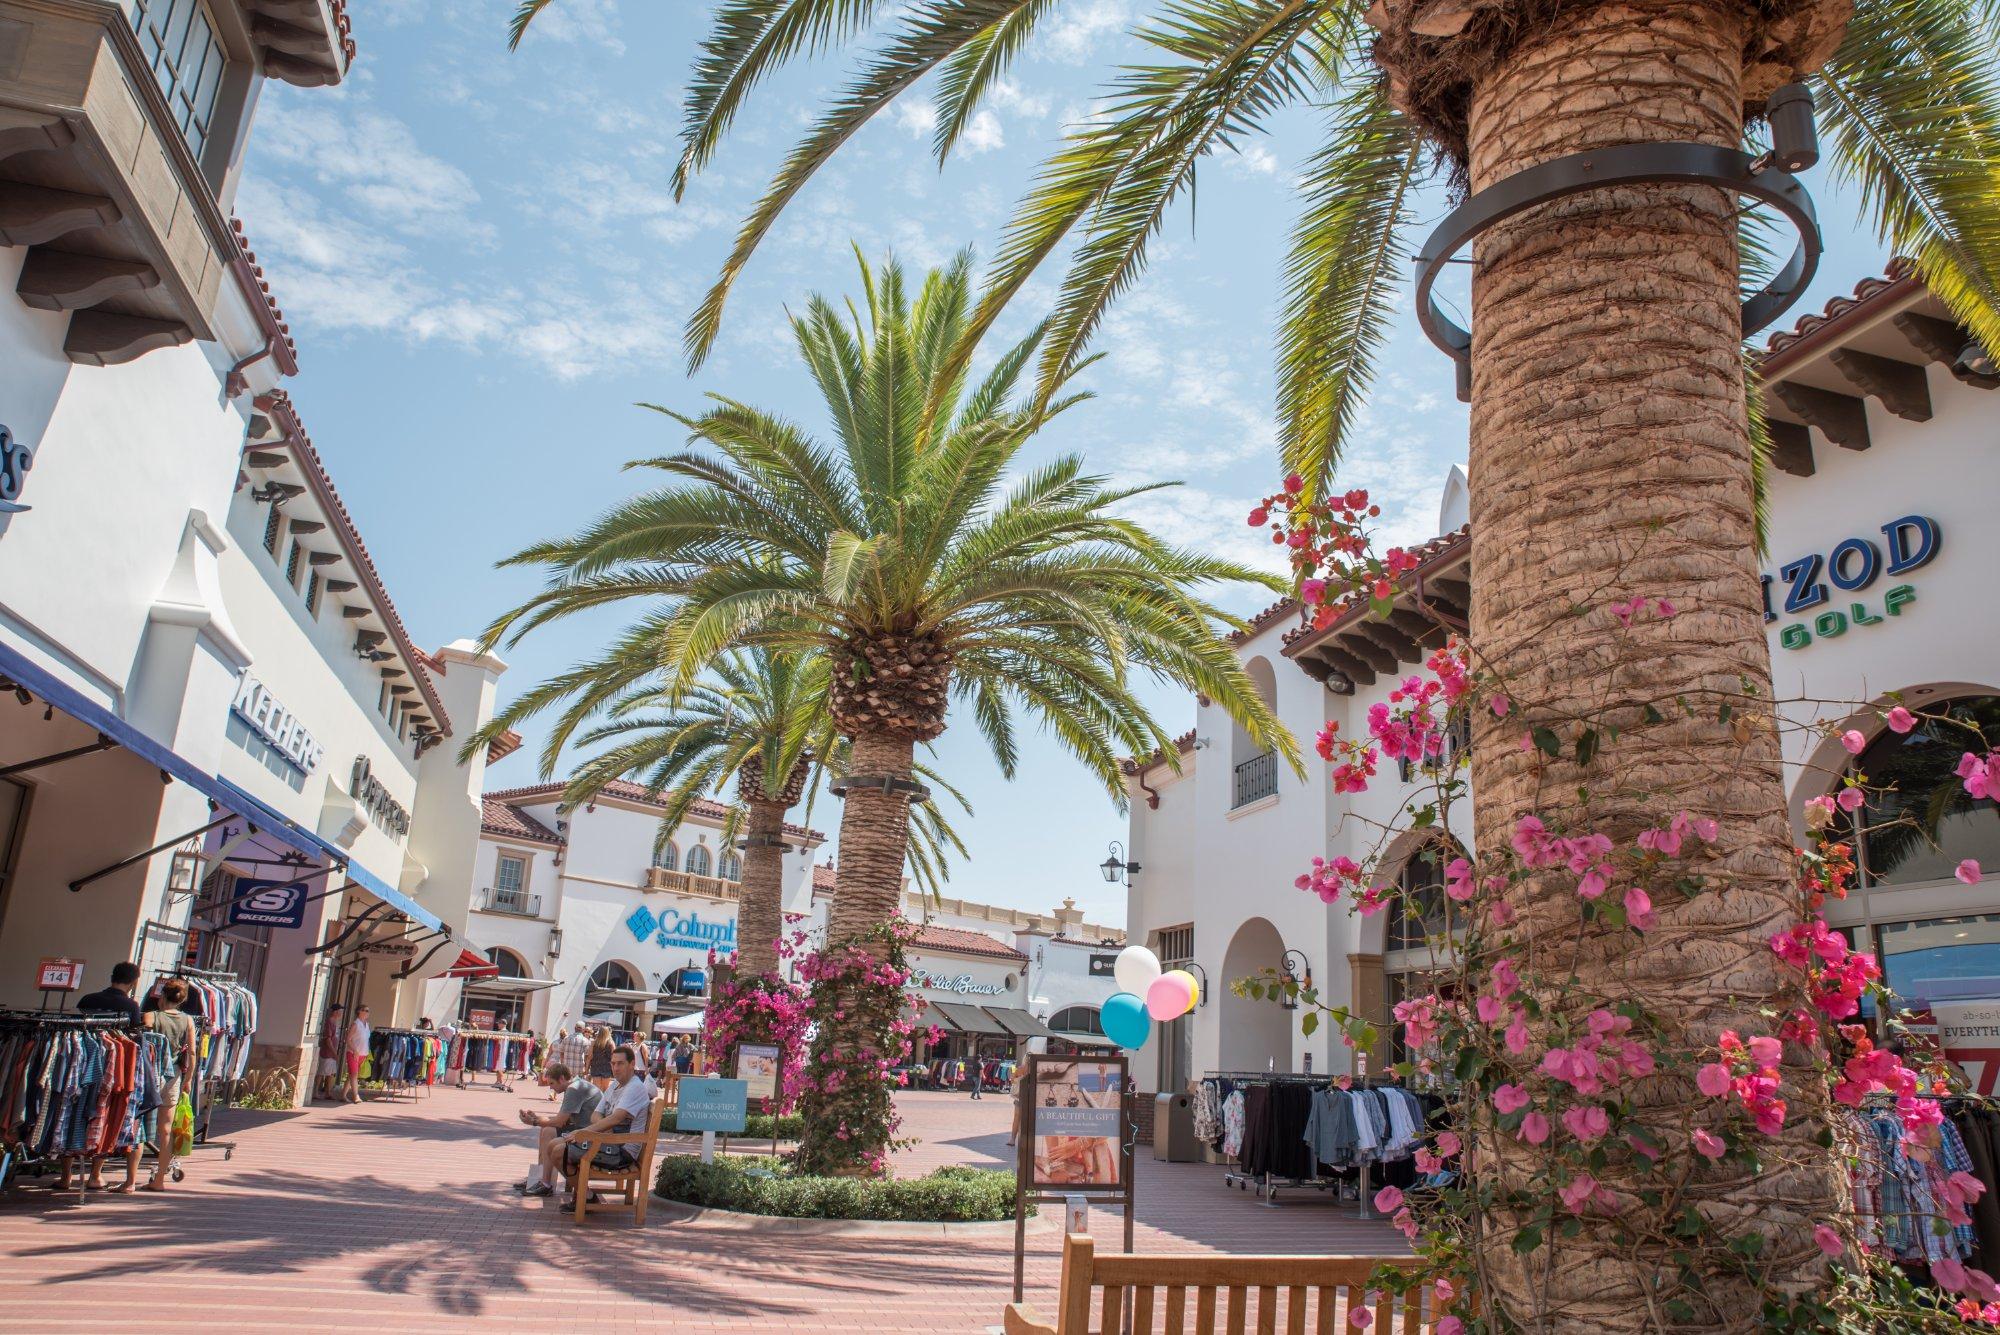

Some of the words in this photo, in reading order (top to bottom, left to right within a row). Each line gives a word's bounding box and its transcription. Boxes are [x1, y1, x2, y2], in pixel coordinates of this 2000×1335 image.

[1780, 585, 1917, 650] GOLF
[236, 913, 295, 924] SKECHERS
[950, 975, 1006, 995] Bauer
[686, 1101, 737, 1110] SMOKE-FREE
[681, 1111, 742, 1120] ENVIRONMENT
[1046, 1112, 1094, 1120] BEAUTIFUL
